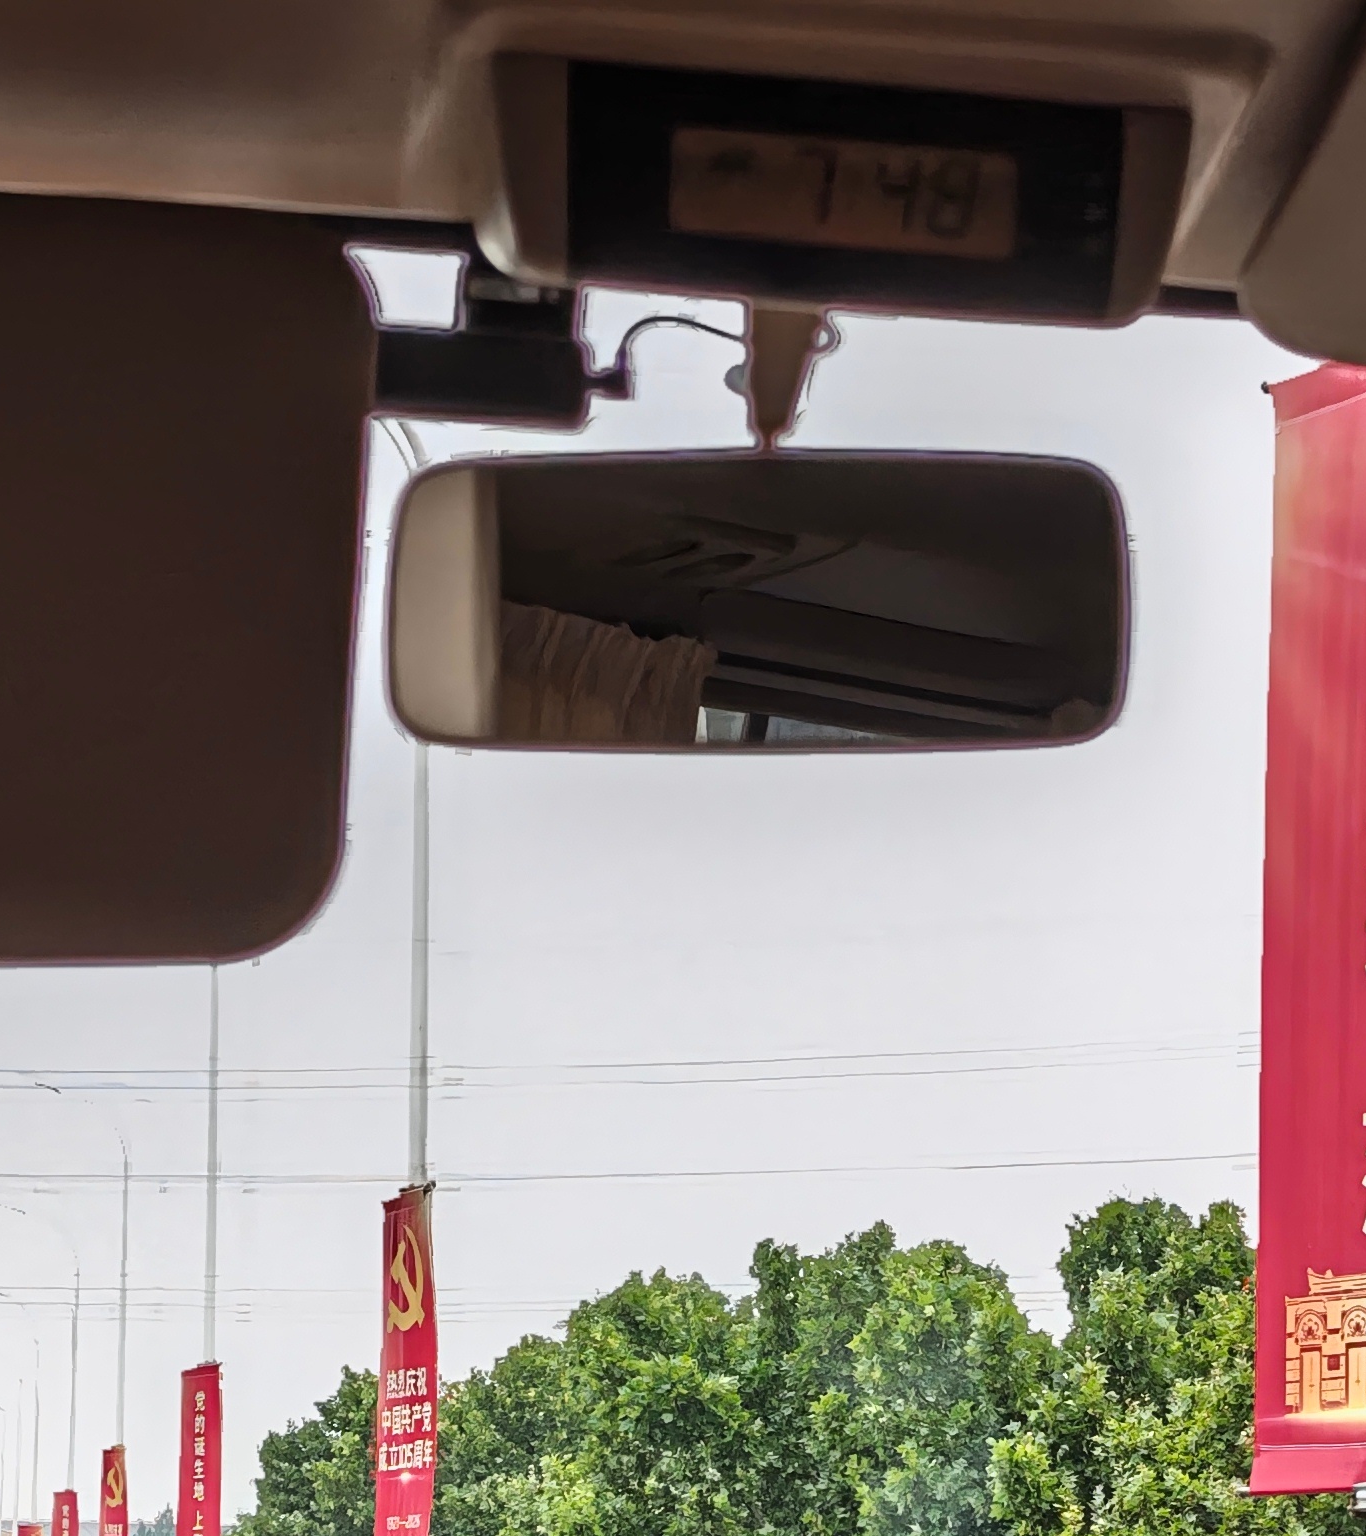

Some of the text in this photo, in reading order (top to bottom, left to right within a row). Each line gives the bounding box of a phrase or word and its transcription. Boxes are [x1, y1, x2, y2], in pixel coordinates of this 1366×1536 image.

[386, 1366, 428, 1400] 热烈庆祝
[381, 1401, 433, 1437] 中国共产党
[377, 1439, 434, 1473] 成立105周年
